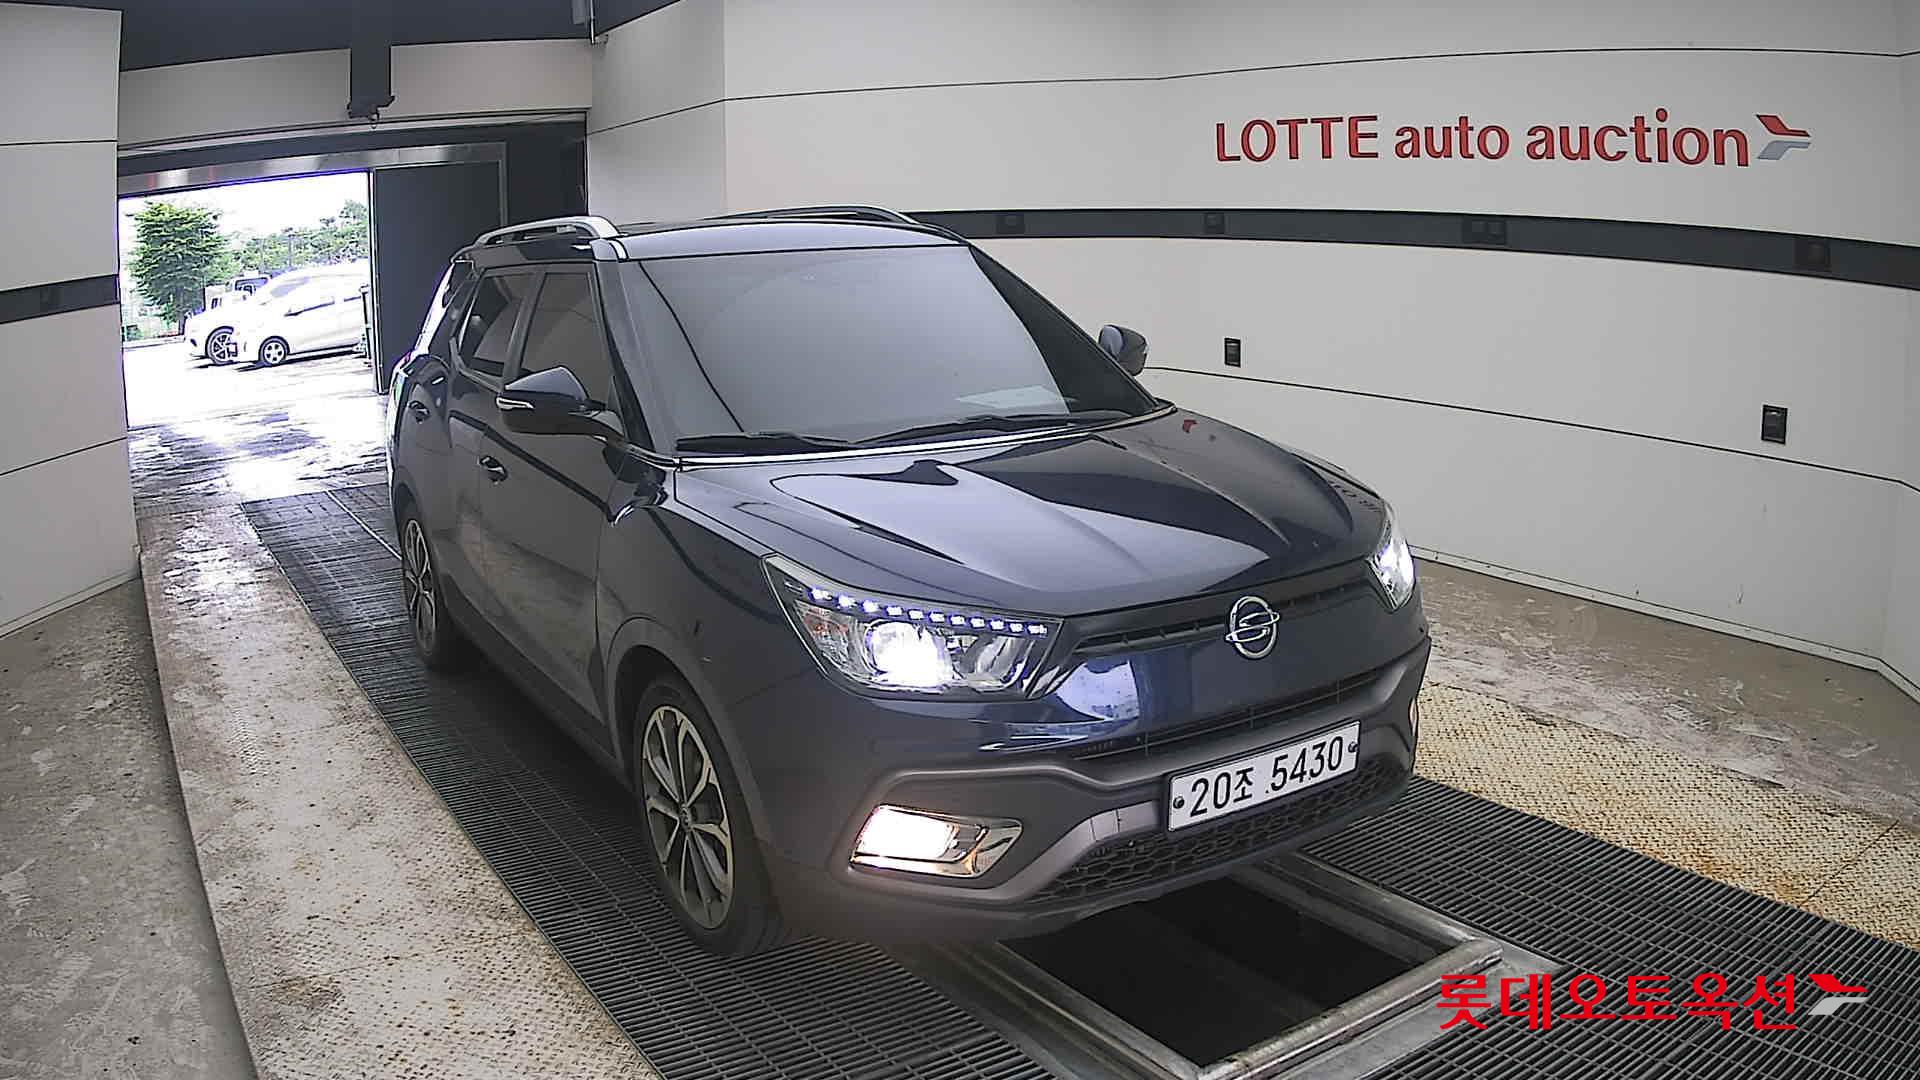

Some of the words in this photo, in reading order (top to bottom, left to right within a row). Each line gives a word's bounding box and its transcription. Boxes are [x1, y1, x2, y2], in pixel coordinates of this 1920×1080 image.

[1215, 114, 1379, 162] LOTTE
[1394, 115, 1510, 161] auto
[1525, 108, 1750, 167] auction
[1190, 767, 1254, 818] 20조
[1270, 736, 1344, 792] 5430
